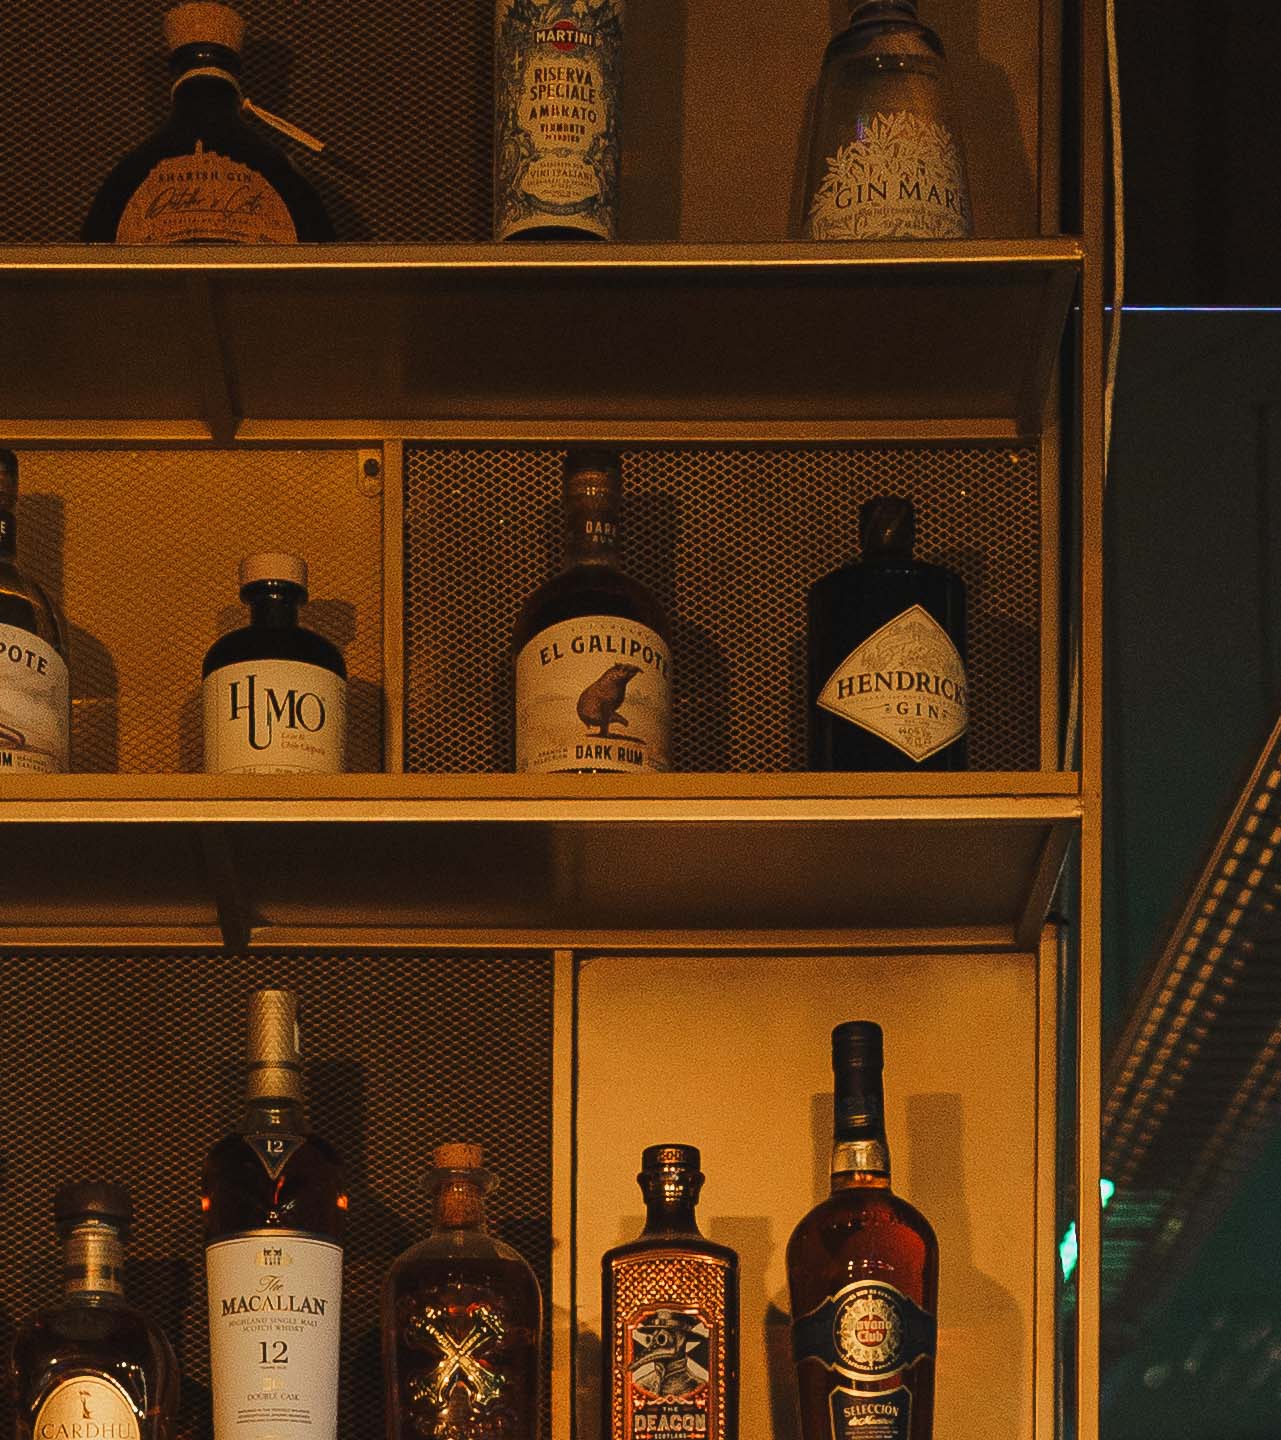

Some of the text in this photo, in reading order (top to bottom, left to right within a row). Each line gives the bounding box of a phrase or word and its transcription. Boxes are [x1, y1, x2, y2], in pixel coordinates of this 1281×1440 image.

[535, 28, 594, 44] MARTINI
[534, 66, 594, 84] RISERVA
[529, 84, 597, 105] SPECIALE
[835, 181, 888, 211] GIN
[540, 647, 566, 666] EL
[836, 671, 961, 701] HENDRICK
[895, 701, 940, 718] GIN
[574, 744, 643, 764] DARK RUM
[265, 1140, 284, 1154] 12
[254, 1274, 283, 1294] The
[221, 1295, 326, 1317] MACALLAN
[856, 1331, 884, 1343] Club
[258, 1339, 289, 1365] 12
[843, 1402, 900, 1418] SELECCIÓN
[40, 1423, 132, 1440] CARDHU
[633, 1415, 707, 1433] DEACON
